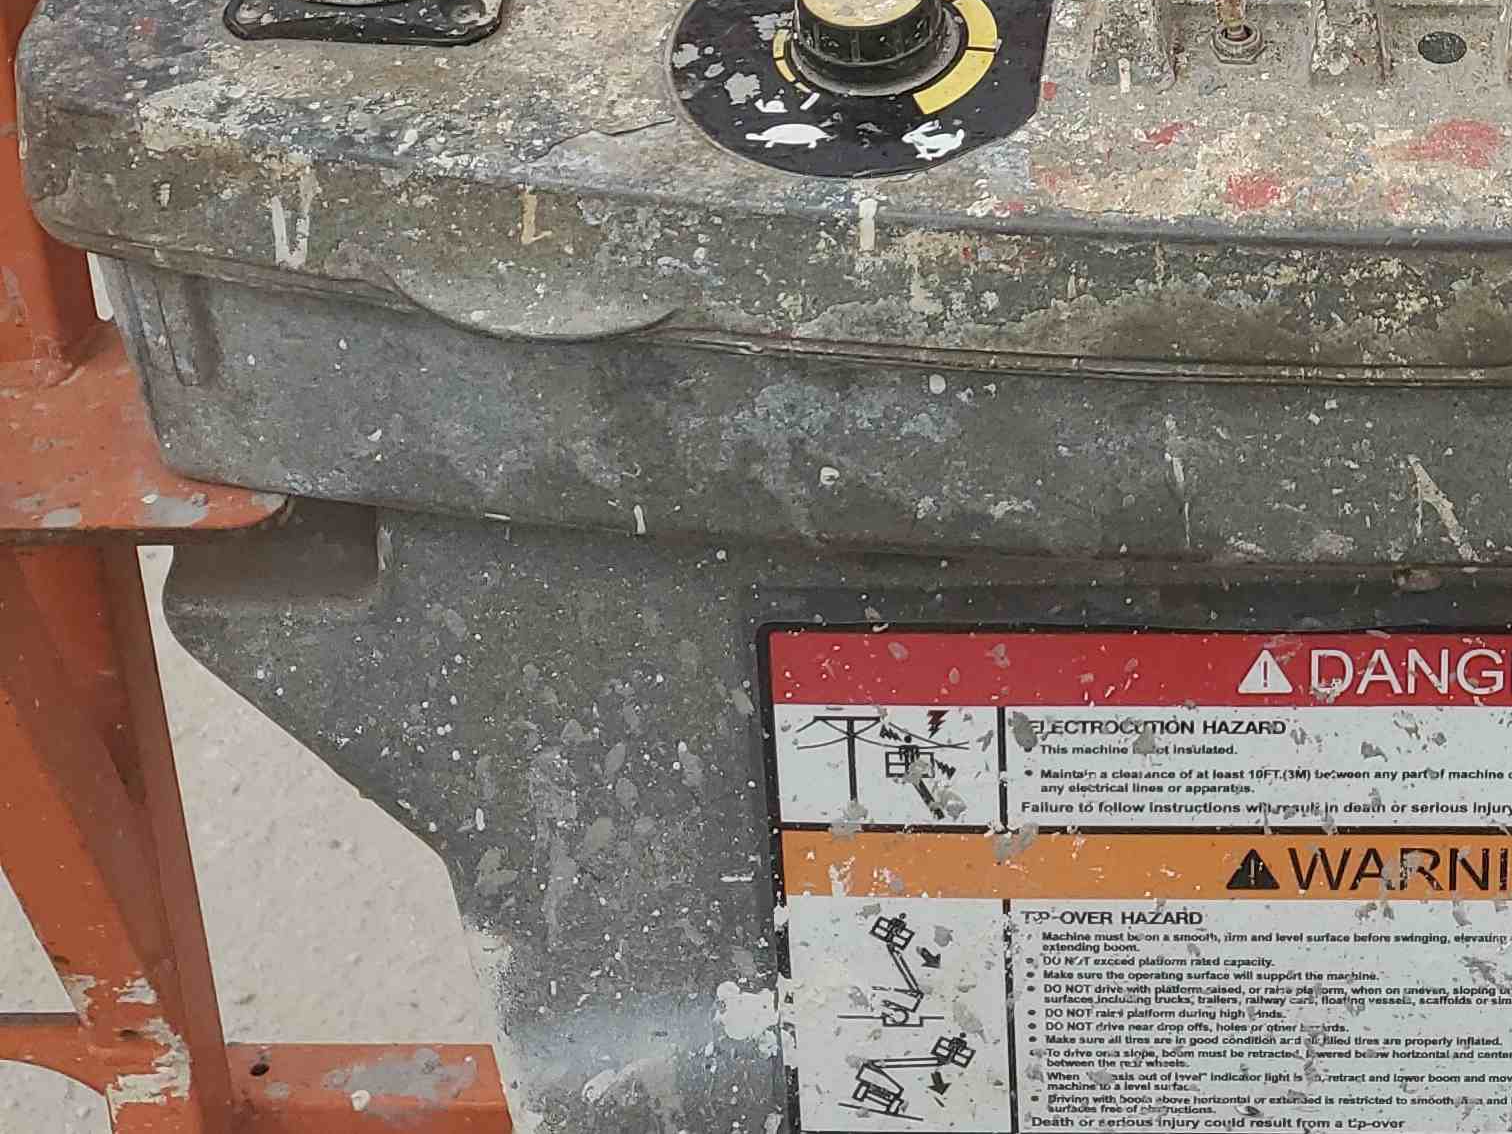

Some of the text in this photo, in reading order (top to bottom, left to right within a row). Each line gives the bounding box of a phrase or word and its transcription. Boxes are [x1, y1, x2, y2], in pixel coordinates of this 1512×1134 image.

[1202, 719, 1287, 735] HAZARD
[1040, 744, 1068, 755] This
[1071, 744, 1129, 755] machine
[1173, 744, 1238, 755] insulated.
[1100, 771, 1108, 780] a
[1179, 769, 1194, 780] of
[1196, 769, 1209, 780] at
[1212, 769, 1245, 780] least
[1374, 771, 1398, 781] any
[1402, 769, 1428, 781] part
[1449, 769, 1504, 780] machine
[1040, 783, 1256, 796] any electrical lines or apparatus.
[1021, 801, 1074, 813] Failure
[1078, 801, 1094, 813] to
[1099, 801, 1146, 813] follow
[1149, 801, 1241, 813] instructions
[1325, 801, 1340, 813] in
[1343, 801, 1386, 813] death
[1390, 804, 1408, 813] or
[1410, 802, 1469, 814] serious
[1022, 911, 1203, 925] TP-OVER HAZARD
[1042, 932, 1451, 945] Machine must and level surface before swinging,
[1041, 942, 1141, 954] extending boom.
[1138, 955, 1276, 968] platform rated capacity.
[1042, 969, 1324, 983] Make the operating surface will support the
[1065, 983, 1497, 998] NOT when sloping
[1154, 994, 1195, 1006] trucks,
[1198, 994, 1242, 1006] trailers,
[1245, 995, 1287, 1007] railway
[1419, 996, 1473, 1006] scaffolds
[1066, 1008, 1246, 1021] NOT platform during high
[1066, 1021, 1247, 1033] NOT drive near drop holes
[1045, 1034, 1504, 1048] Make good condition tires properly inflated.
[1063, 1048, 1093, 1058] drive
[1197, 1049, 1228, 1059] must
[1392, 1049, 1450, 1059] horizontal
[1452, 1050, 1475, 1059] and
[1046, 1058, 1095, 1068] between
[1046, 1071, 1081, 1081] When
[1210, 1072, 1261, 1082] indicator
[1264, 1072, 1290, 1084] light
[1368, 1073, 1391, 1083] and
[1393, 1073, 1426, 1083] lower
[1428, 1073, 1462, 1083] boom
[1463, 1073, 1485, 1083] and
[1046, 1081, 1151, 1091] machine level
[1047, 1094, 1090, 1106] Driving
[1192, 1095, 1251, 1105] horizontal
[1337, 1095, 1393, 1105] restricted
[1485, 1095, 1508, 1105] and
[1031, 1116, 1330, 1129] Death injury could result from
